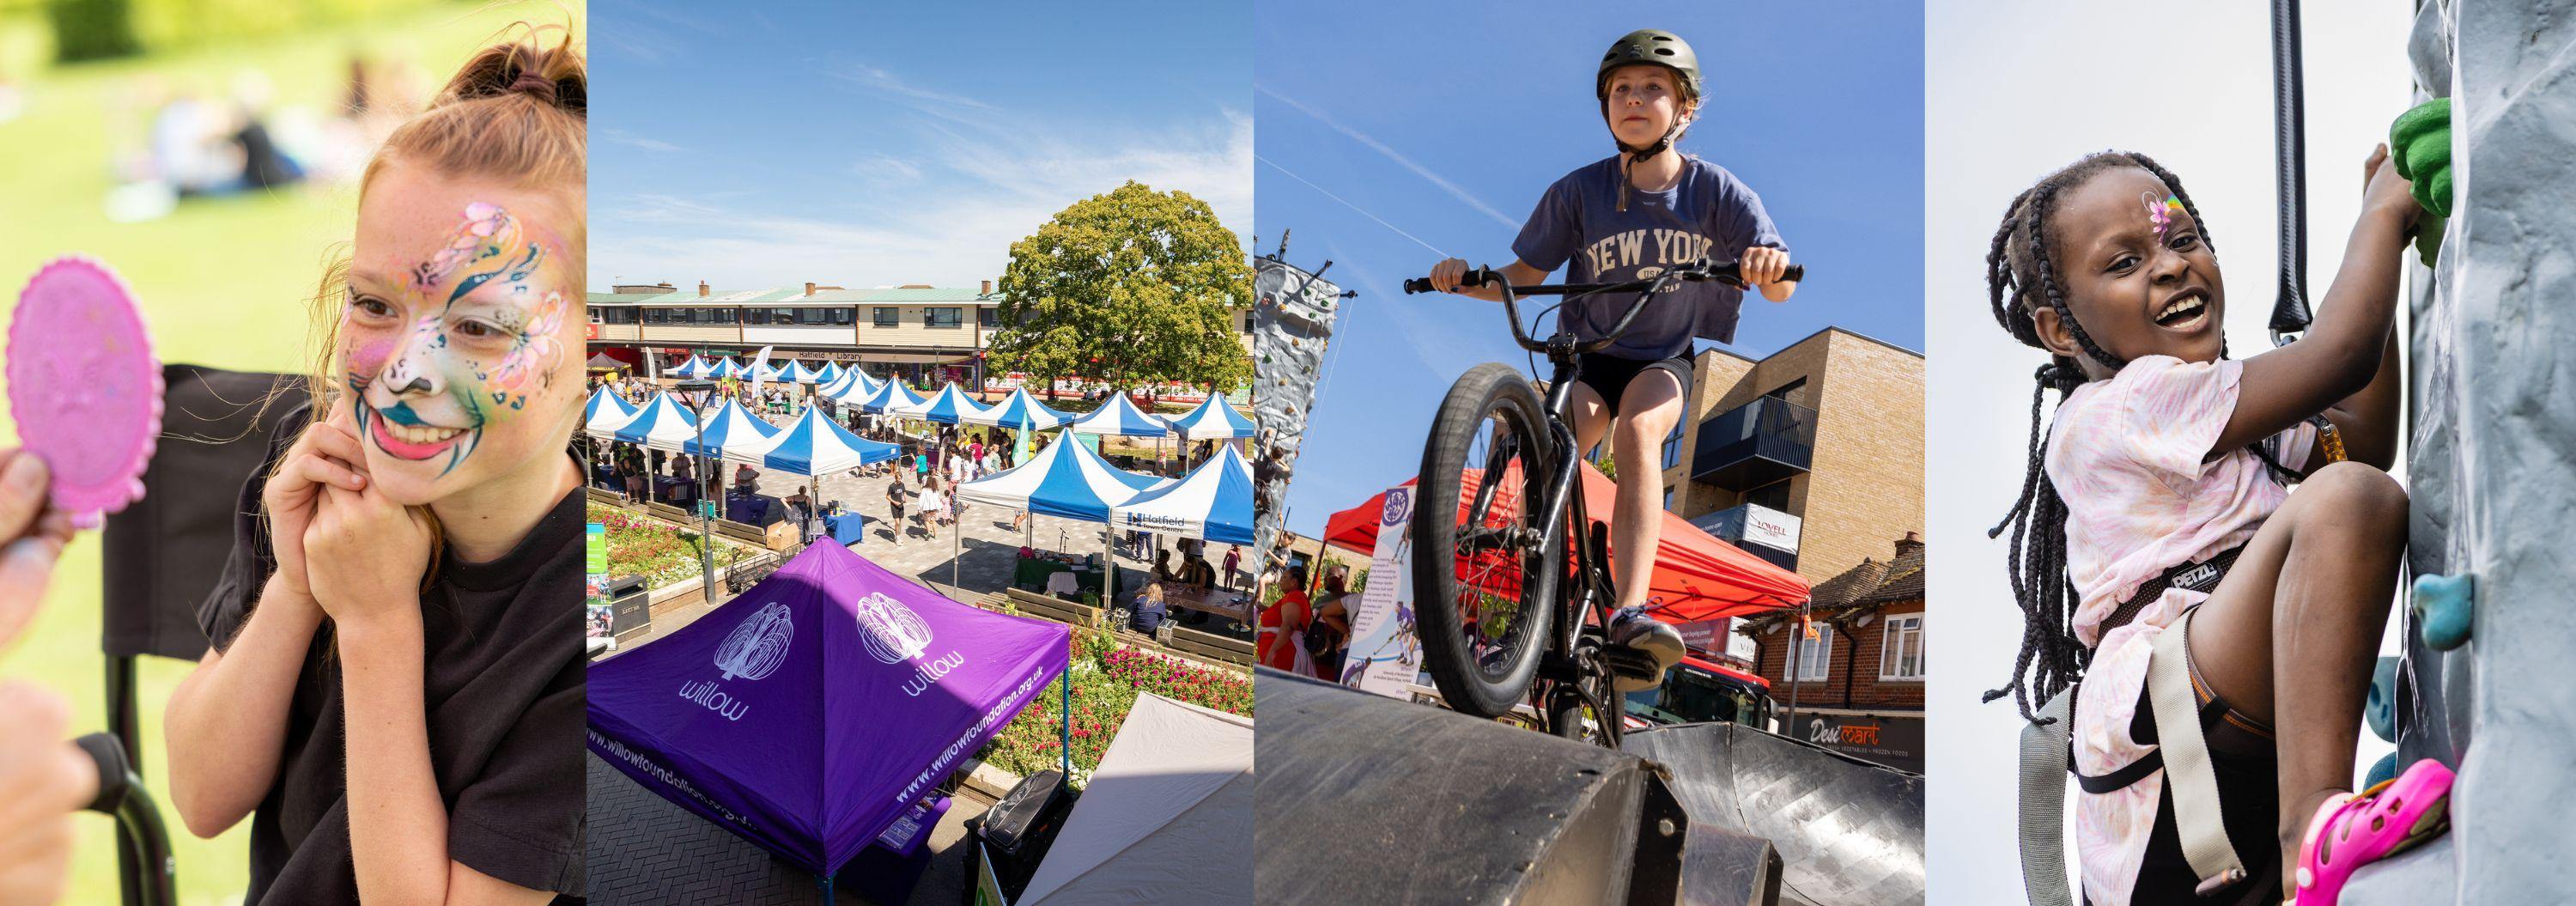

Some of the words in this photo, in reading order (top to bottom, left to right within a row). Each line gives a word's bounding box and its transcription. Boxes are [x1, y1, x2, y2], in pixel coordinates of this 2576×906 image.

[1587, 228, 1647, 278] NEW
[1653, 228, 1713, 265] YORK
[799, 350, 825, 359] Hatfield
[836, 351, 863, 361] Library
[1142, 513, 1185, 526] Hatfield
[1162, 525, 1184, 533] Centre
[1758, 520, 1787, 536] LOVELL
[2172, 563, 2218, 589] PETZL
[902, 650, 964, 696] willow
[678, 679, 750, 721] willow
[896, 666, 1044, 804] www.willowfoundation.org.uk
[1810, 718, 1841, 744] Desi
[1841, 722, 1880, 745] mart
